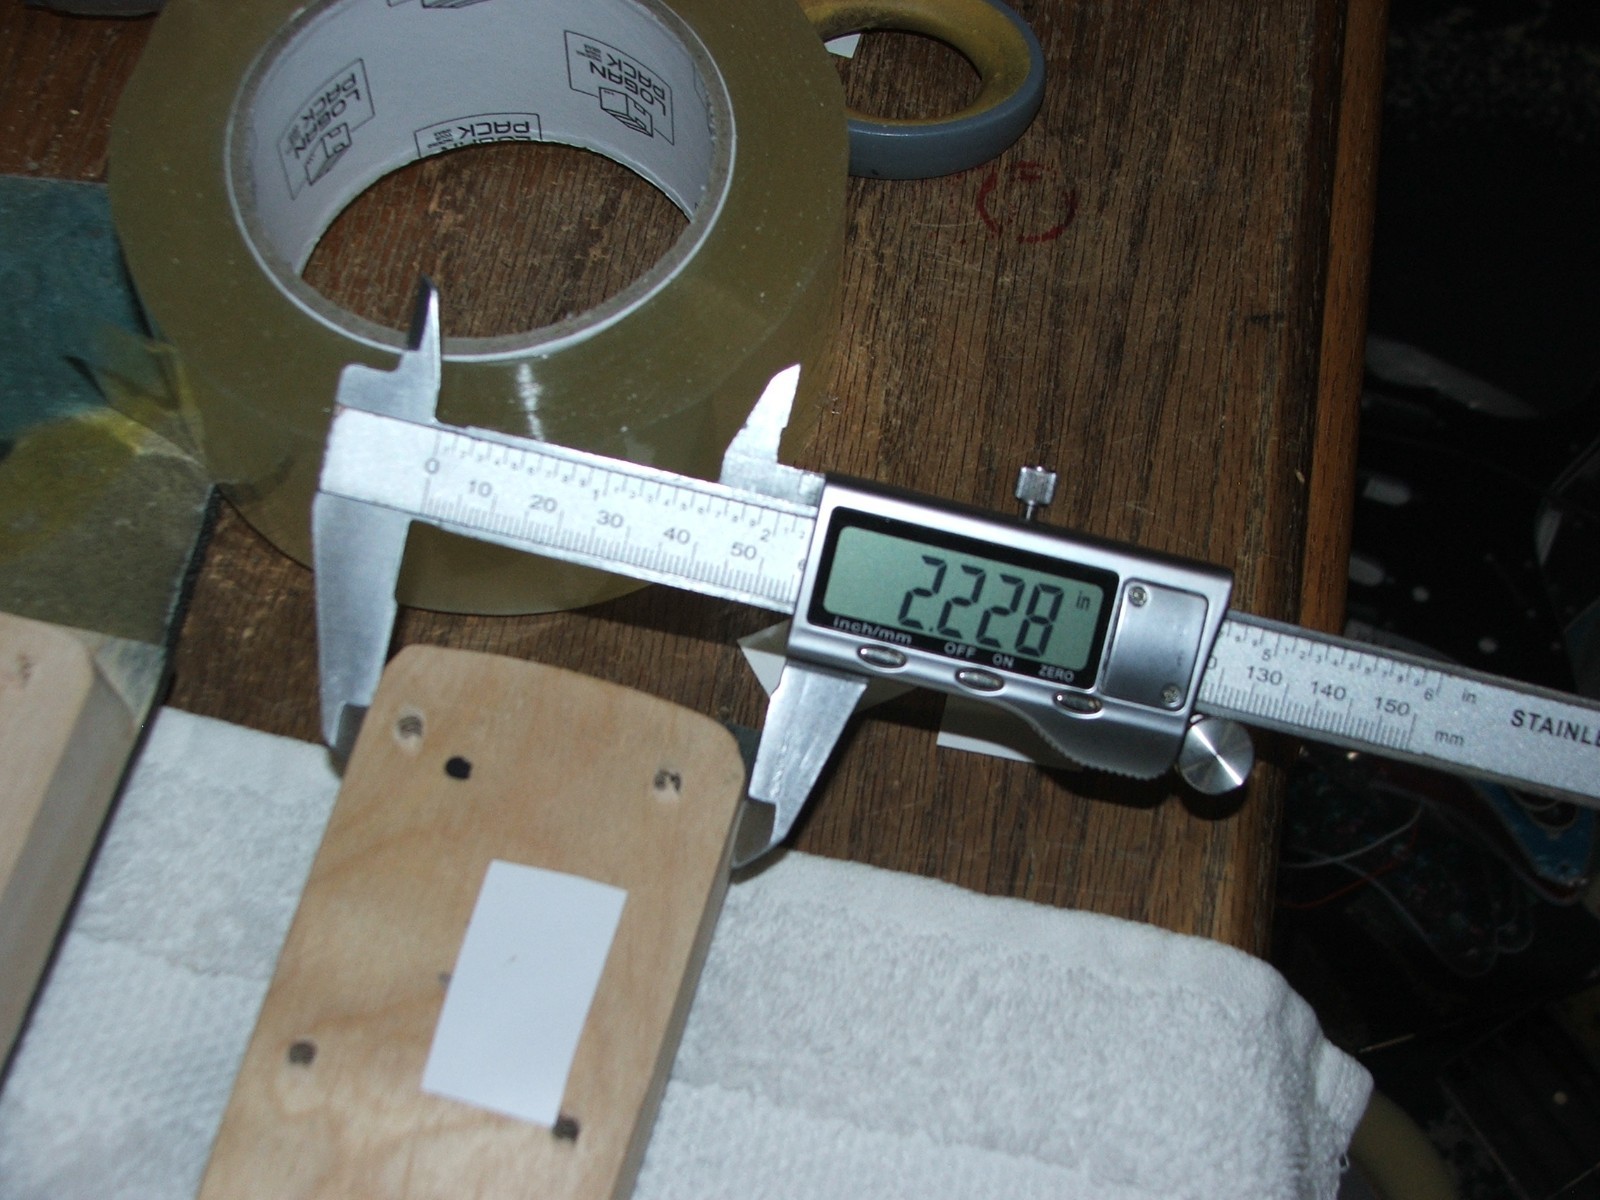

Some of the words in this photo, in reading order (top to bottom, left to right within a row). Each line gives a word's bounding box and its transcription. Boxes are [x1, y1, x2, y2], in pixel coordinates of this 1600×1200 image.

[303, 72, 357, 122] PACK
[589, 60, 667, 117] LOGAN
[606, 54, 666, 103] PACK
[458, 120, 530, 140] PACK
[424, 457, 440, 474] 0
[469, 479, 492, 497] 10
[529, 494, 558, 513] 20
[596, 510, 624, 528] 30
[663, 527, 691, 544] 40
[730, 542, 757, 560] 50
[760, 528, 771, 542] 2
[898, 554, 1065, 658] 2.228
[1076, 590, 1091, 611] in
[833, 615, 912, 647] inch/mm
[944, 642, 977, 659] OFF
[992, 653, 1015, 668] ON
[1038, 664, 1075, 683] ZERO
[1261, 648, 1271, 661] 5
[1424, 688, 1434, 701] 6
[1462, 688, 1477, 704] in
[1247, 665, 1282, 686] 130
[1311, 681, 1346, 700] 140
[1375, 697, 1410, 716] 150
[1435, 730, 1465, 746] mm
